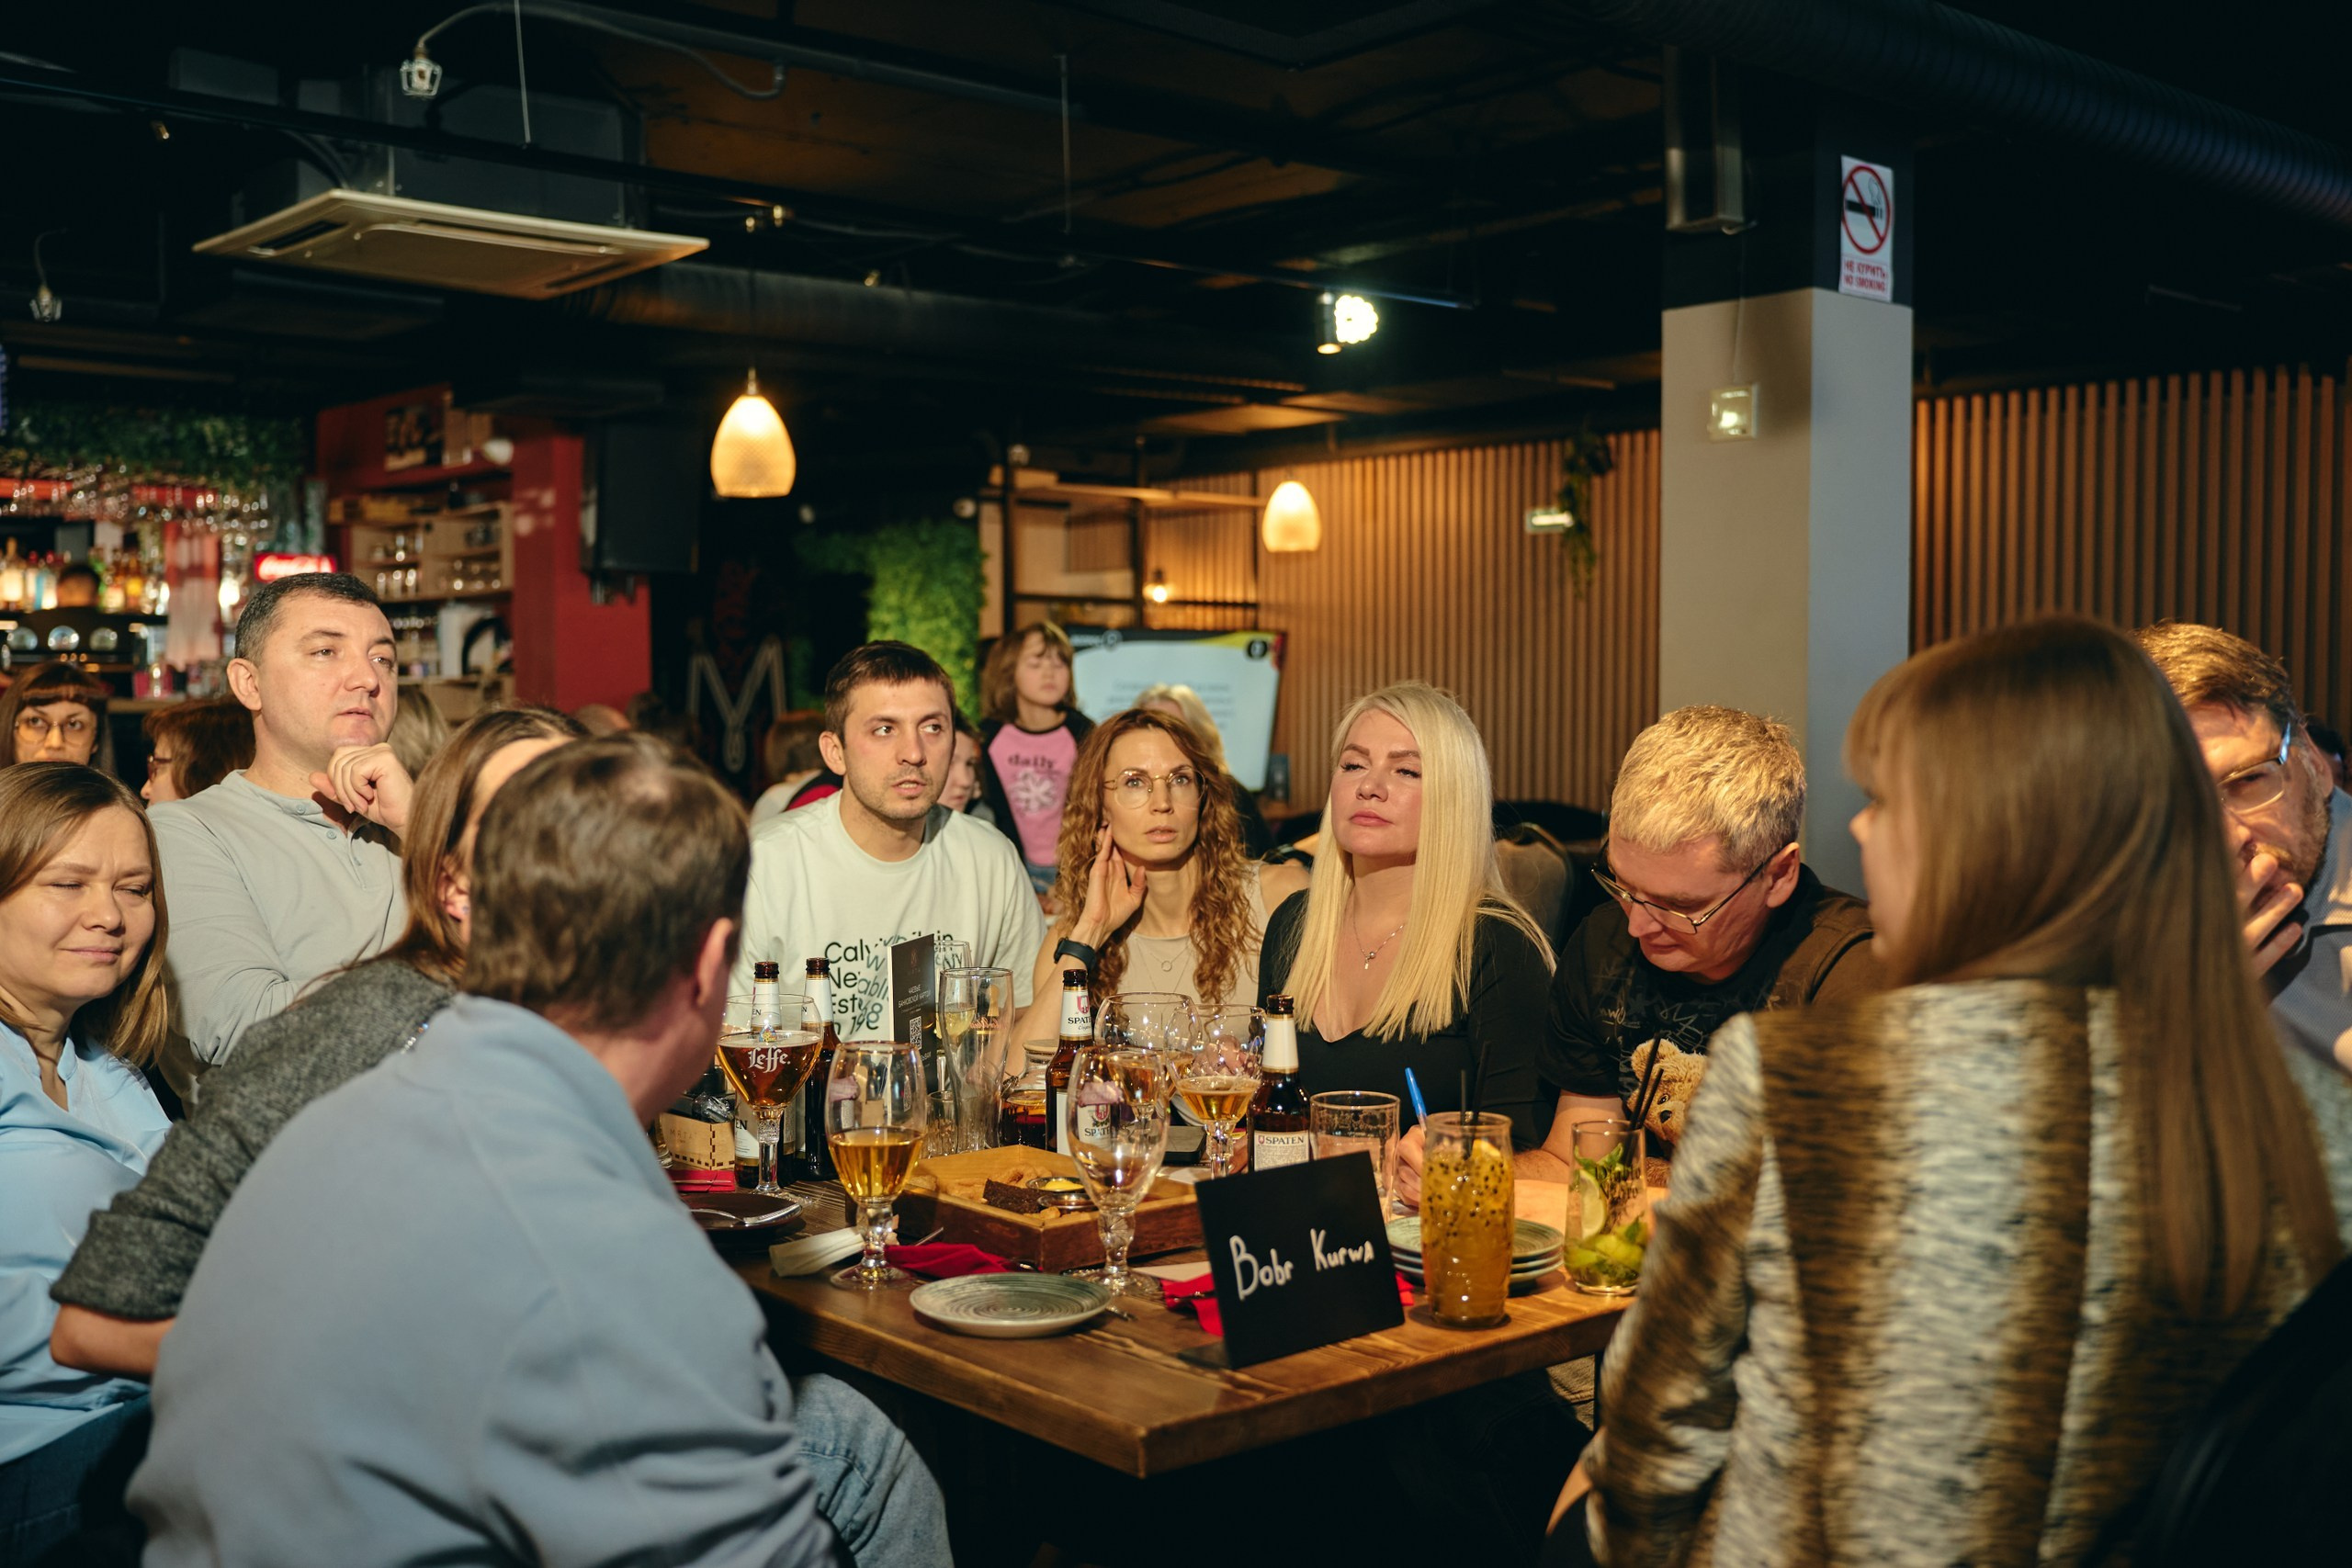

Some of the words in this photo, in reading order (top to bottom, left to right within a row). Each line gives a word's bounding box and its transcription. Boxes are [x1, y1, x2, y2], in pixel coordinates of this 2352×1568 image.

[1844, 275, 1853, 286] NO
[1265, 1135, 1305, 1145] SPATEN
[1229, 1235, 1294, 1301] Bobr
